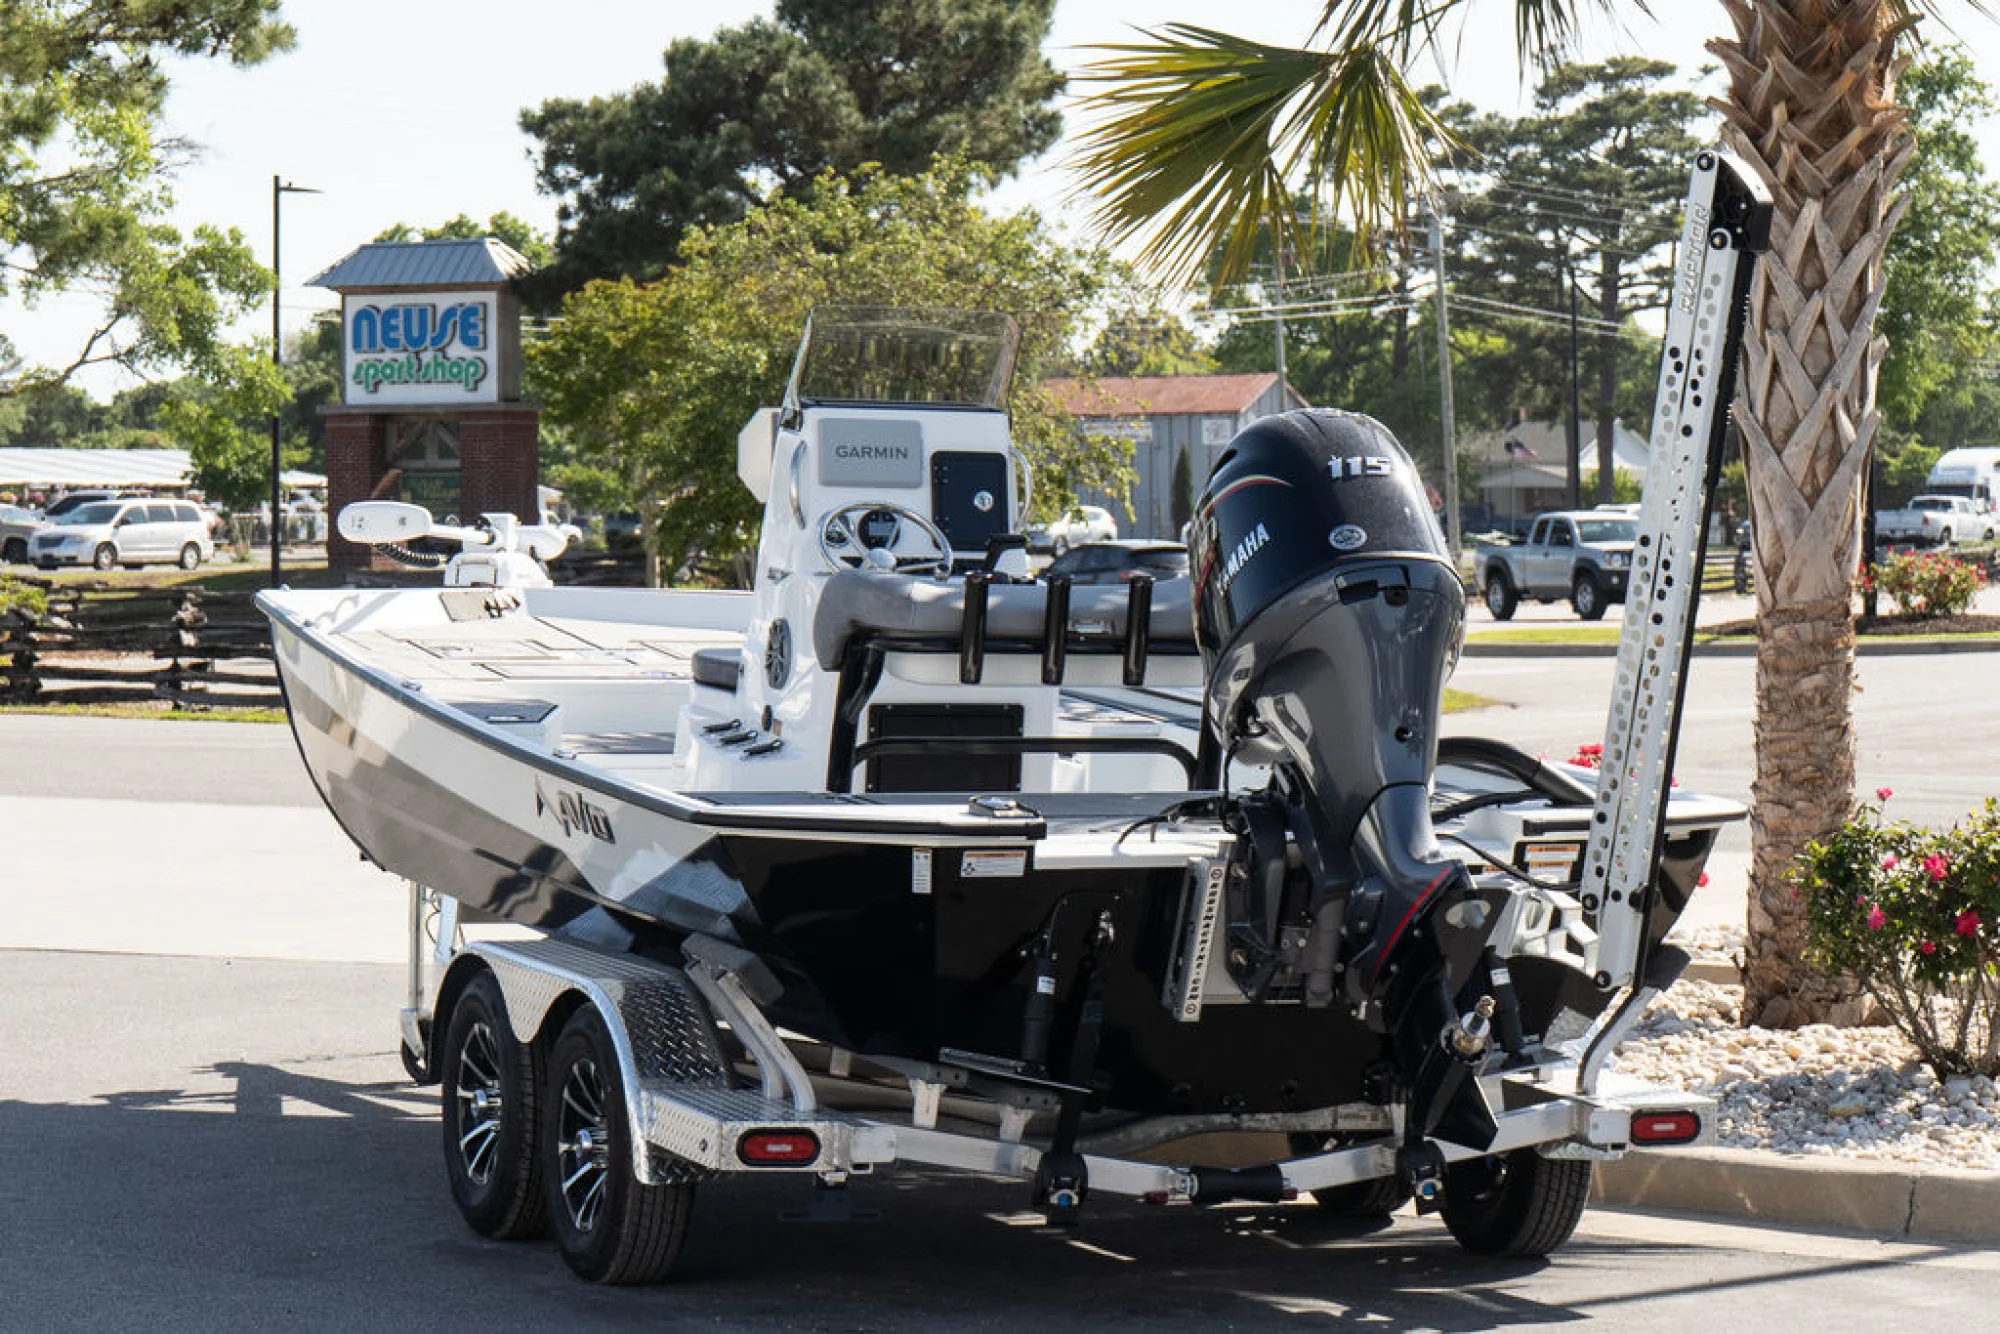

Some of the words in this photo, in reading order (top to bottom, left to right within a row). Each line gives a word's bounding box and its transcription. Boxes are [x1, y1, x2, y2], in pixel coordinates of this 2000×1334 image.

[352, 303, 486, 352] NEUSE
[353, 354, 416, 393] sport
[421, 353, 486, 391] shop
[835, 444, 908, 460] GARMIN
[1328, 455, 1390, 478] 115
